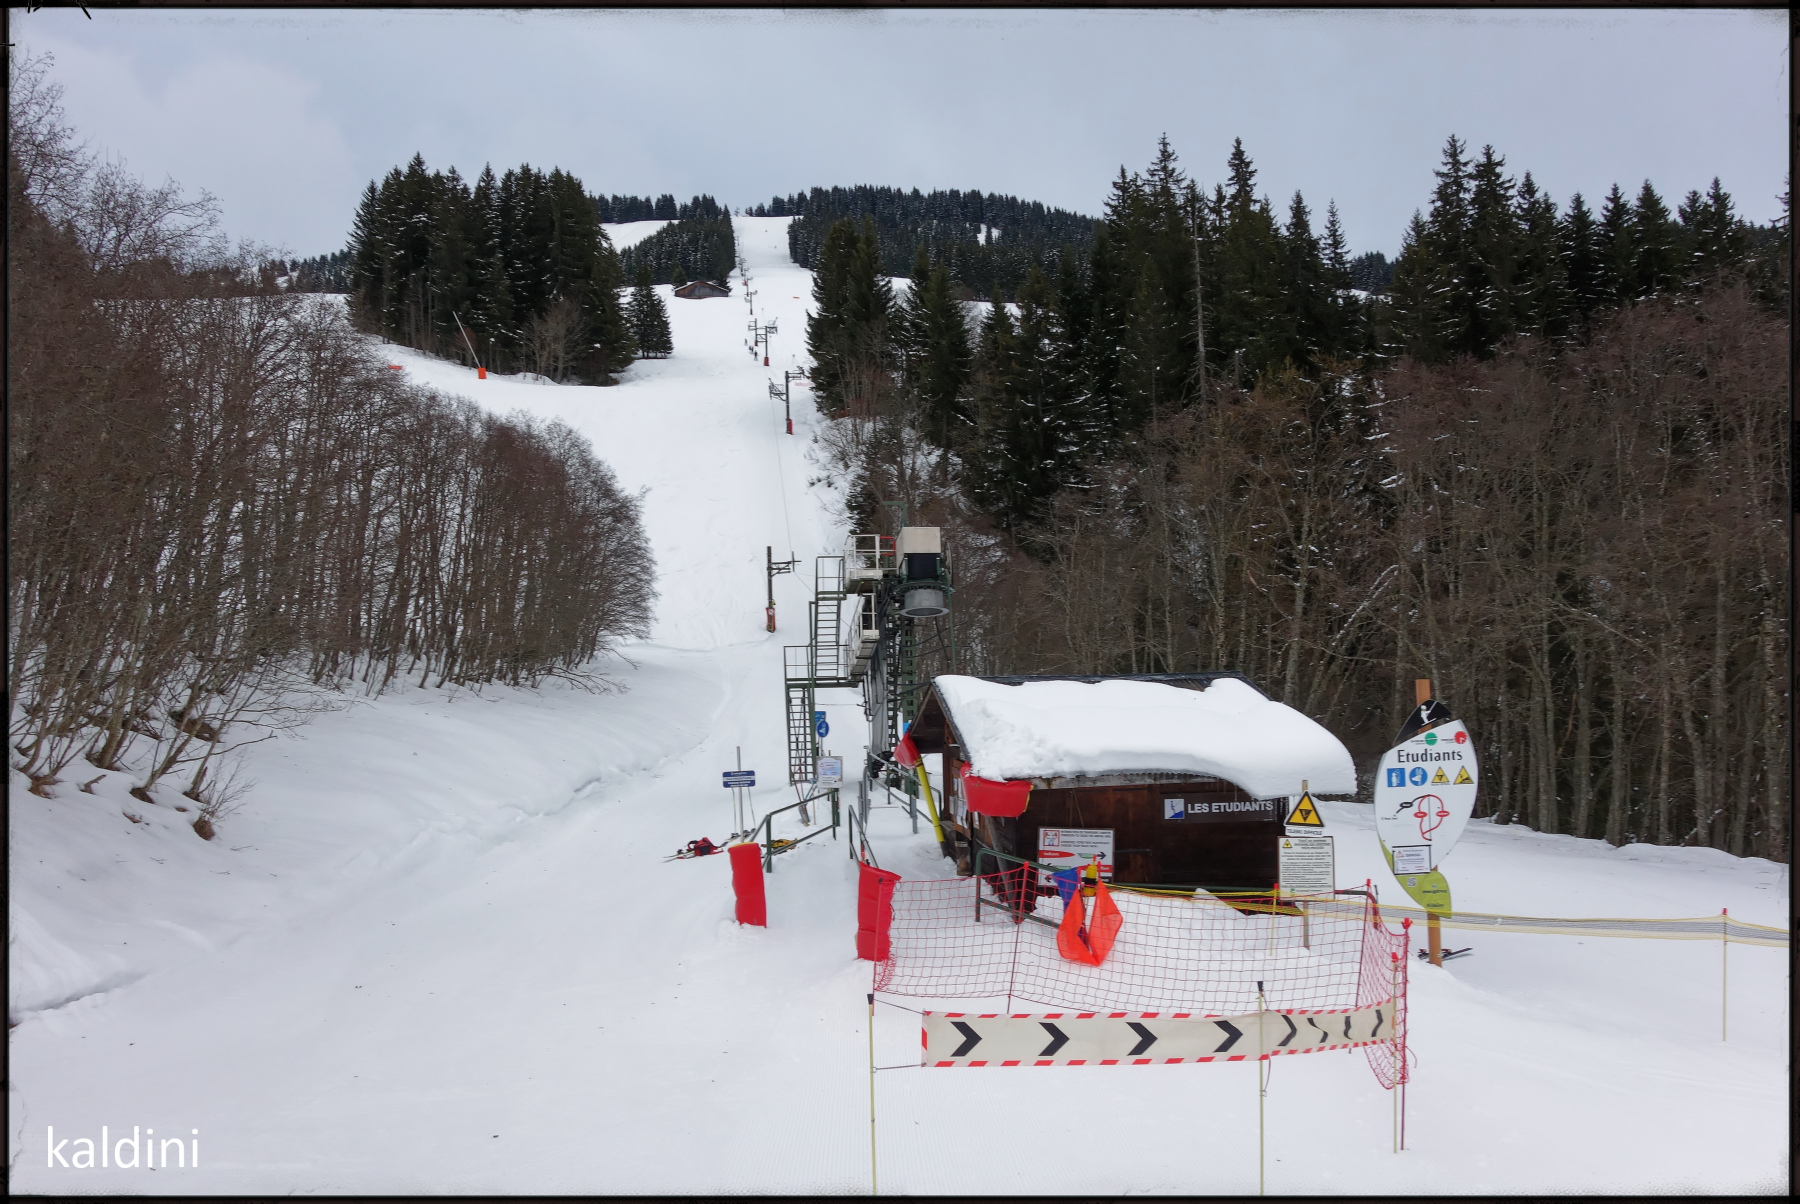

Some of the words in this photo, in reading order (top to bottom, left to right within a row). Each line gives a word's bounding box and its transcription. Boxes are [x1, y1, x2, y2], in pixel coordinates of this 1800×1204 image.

[1397, 748, 1463, 763] Etudiants
[1187, 803, 1209, 814] LES
[1211, 801, 1274, 813] ETUDIANTS
